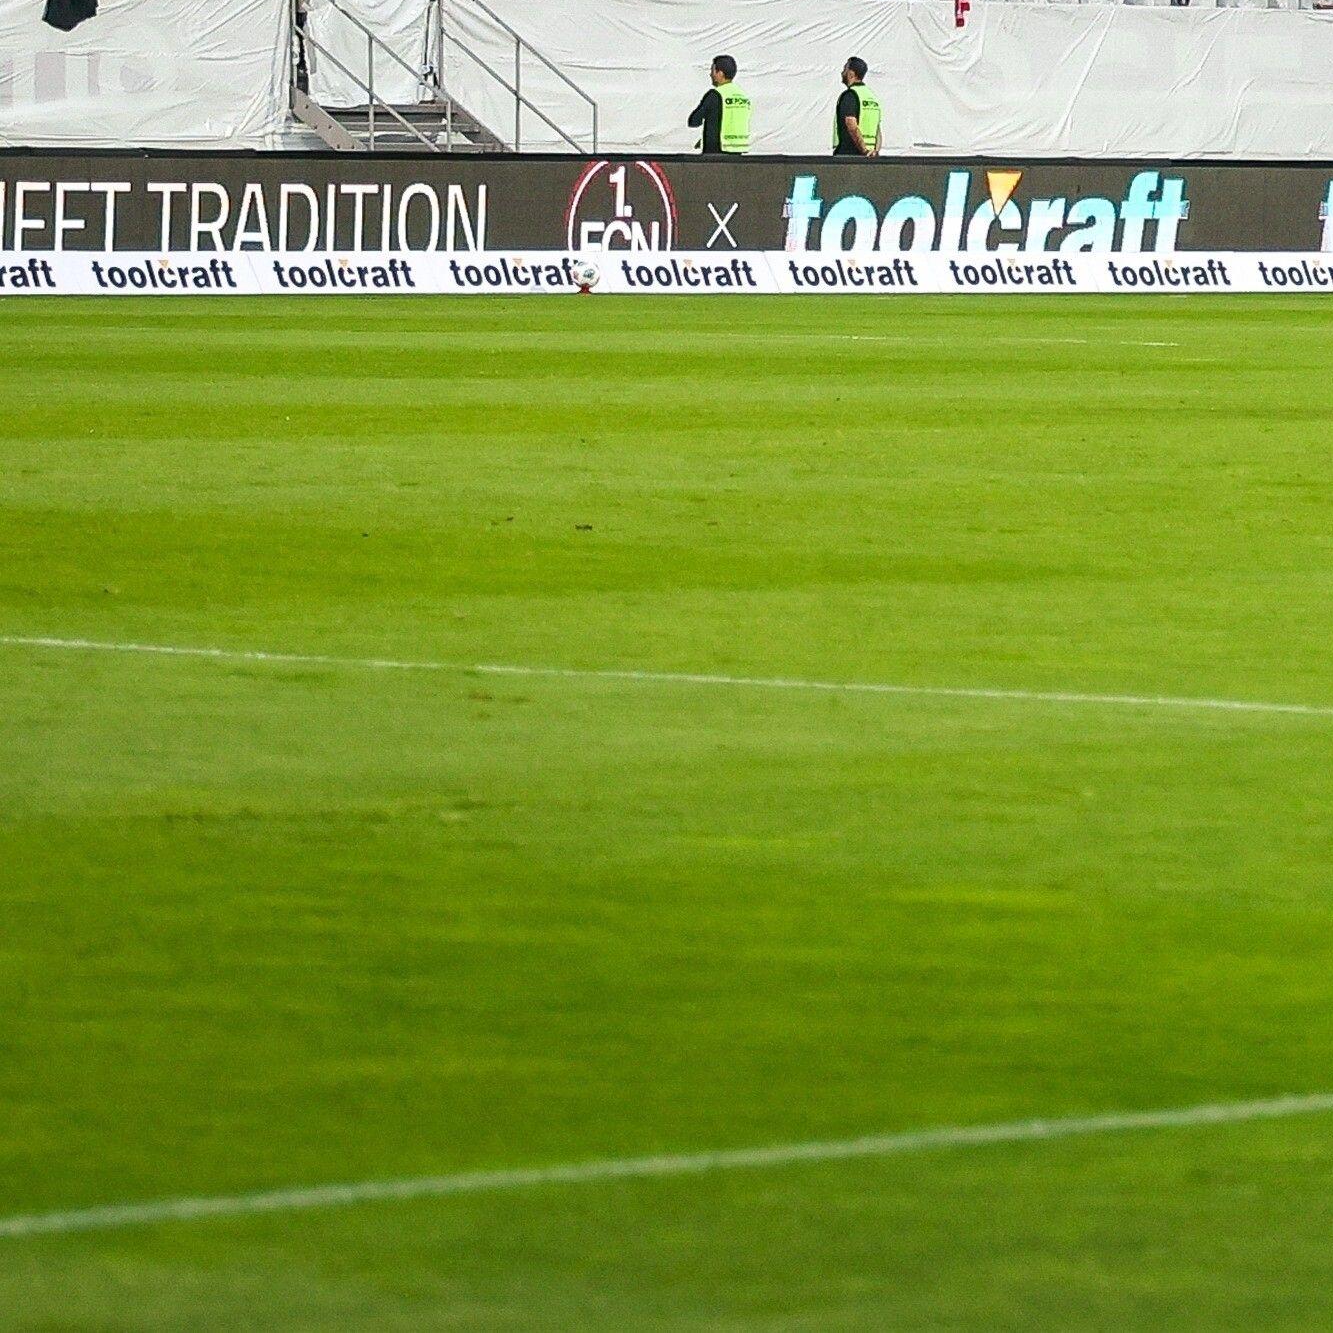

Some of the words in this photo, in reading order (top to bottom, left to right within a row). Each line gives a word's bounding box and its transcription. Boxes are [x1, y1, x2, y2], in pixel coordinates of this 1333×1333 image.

[0, 181, 131, 251] EET
[147, 182, 486, 251] TRADITION
[784, 170, 1189, 252] toolcraft
[92, 258, 238, 288] toolcraft
[273, 258, 415, 287] toolcraft
[450, 257, 579, 286] toolcraf
[622, 258, 757, 287] toolcraft
[787, 258, 918, 287] toolcraft
[950, 258, 1077, 286] toolcraft
[1108, 258, 1232, 286] toolcraft
